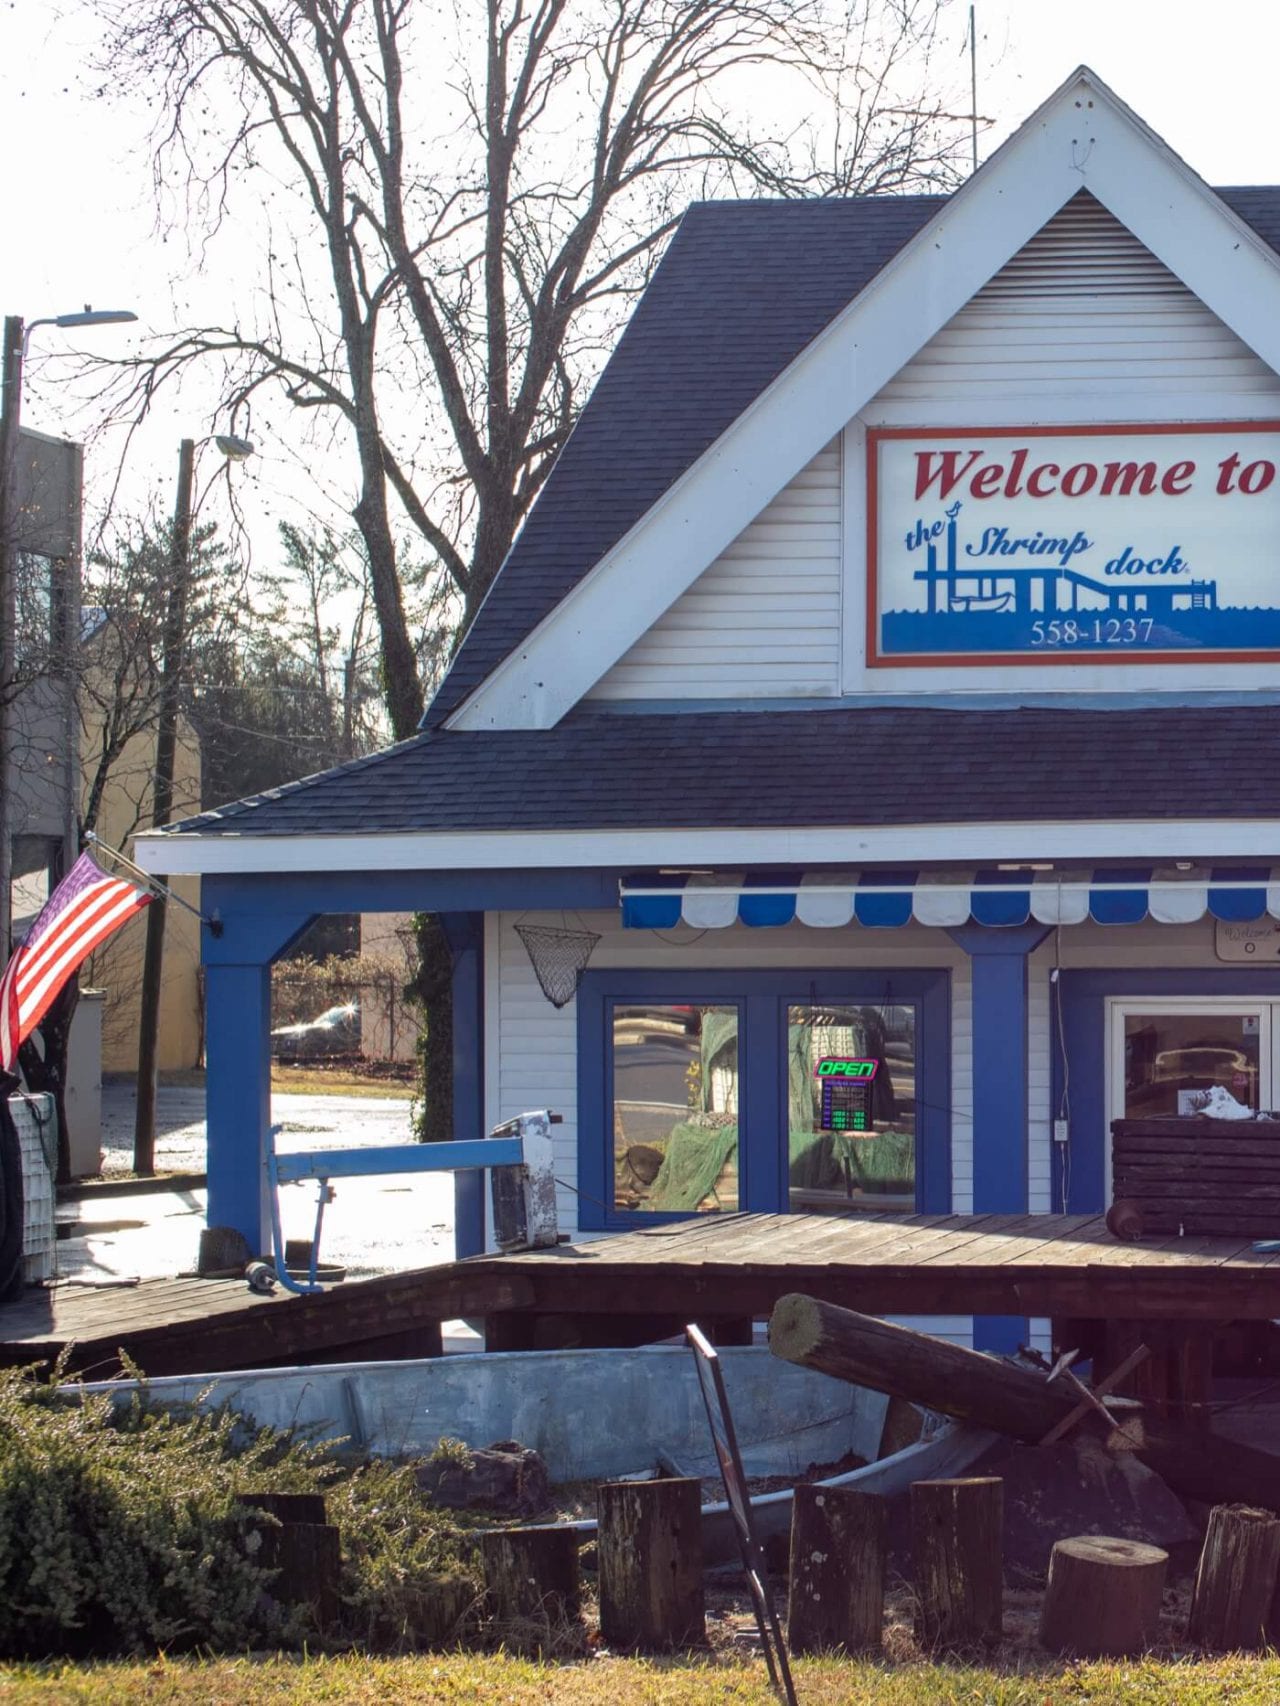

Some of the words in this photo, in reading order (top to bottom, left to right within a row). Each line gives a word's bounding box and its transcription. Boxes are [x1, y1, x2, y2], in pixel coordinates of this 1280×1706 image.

[914, 448, 1196, 501] Welcome
[1215, 452, 1277, 496] to
[904, 518, 946, 552] the
[965, 526, 1095, 566] Shrimp
[1104, 545, 1189, 576] dock
[1030, 617, 1155, 645] 558-1237
[818, 1061, 875, 1077] OPEN
